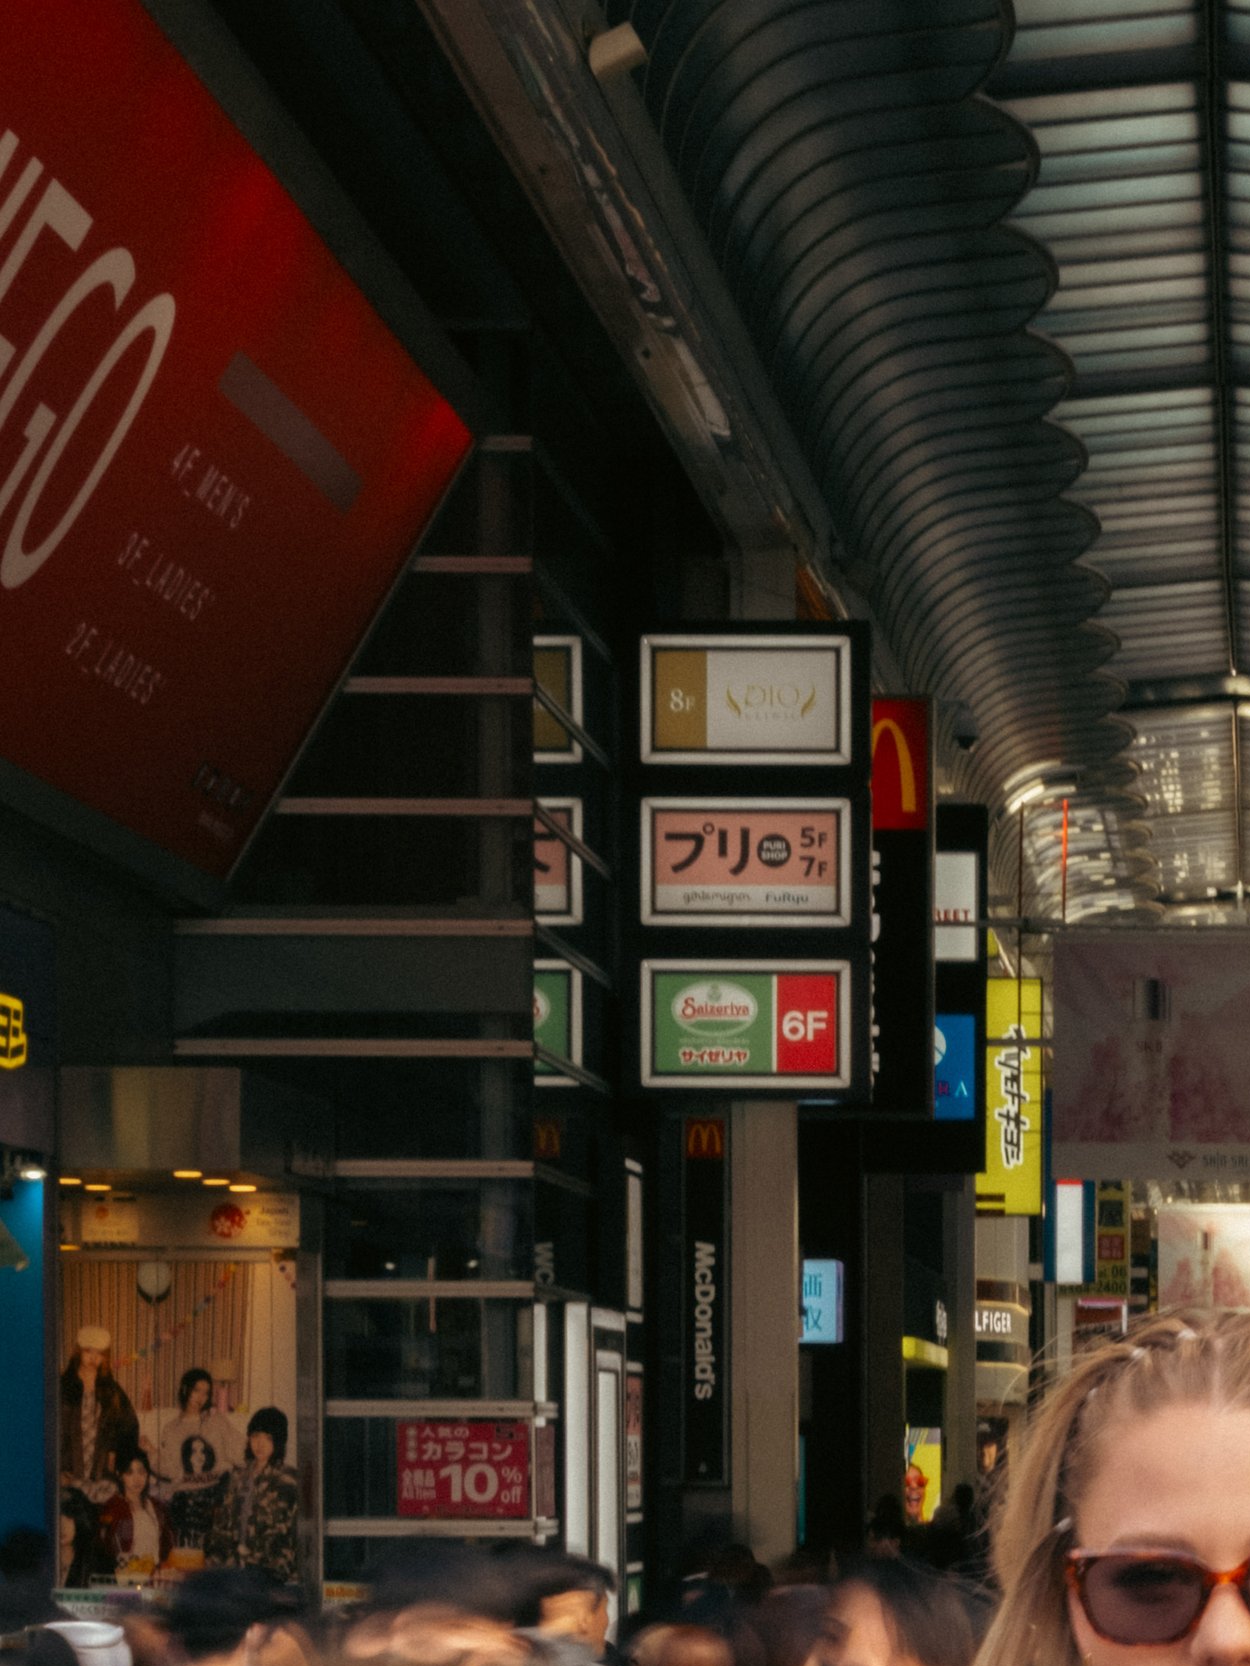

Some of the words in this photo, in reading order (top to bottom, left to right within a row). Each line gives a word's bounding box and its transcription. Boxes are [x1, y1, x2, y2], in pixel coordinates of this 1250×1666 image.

[669, 687, 695, 713] 8F
[664, 822, 751, 876] プリ
[800, 827, 827, 848] 5F
[800, 857, 827, 878] 7F
[782, 1010, 829, 1042] 6F
[694, 1241, 716, 1400] McDonald's
[420, 1441, 513, 1462] カラコン
[440, 1462, 500, 1504] 10
[501, 1485, 523, 1504] off
